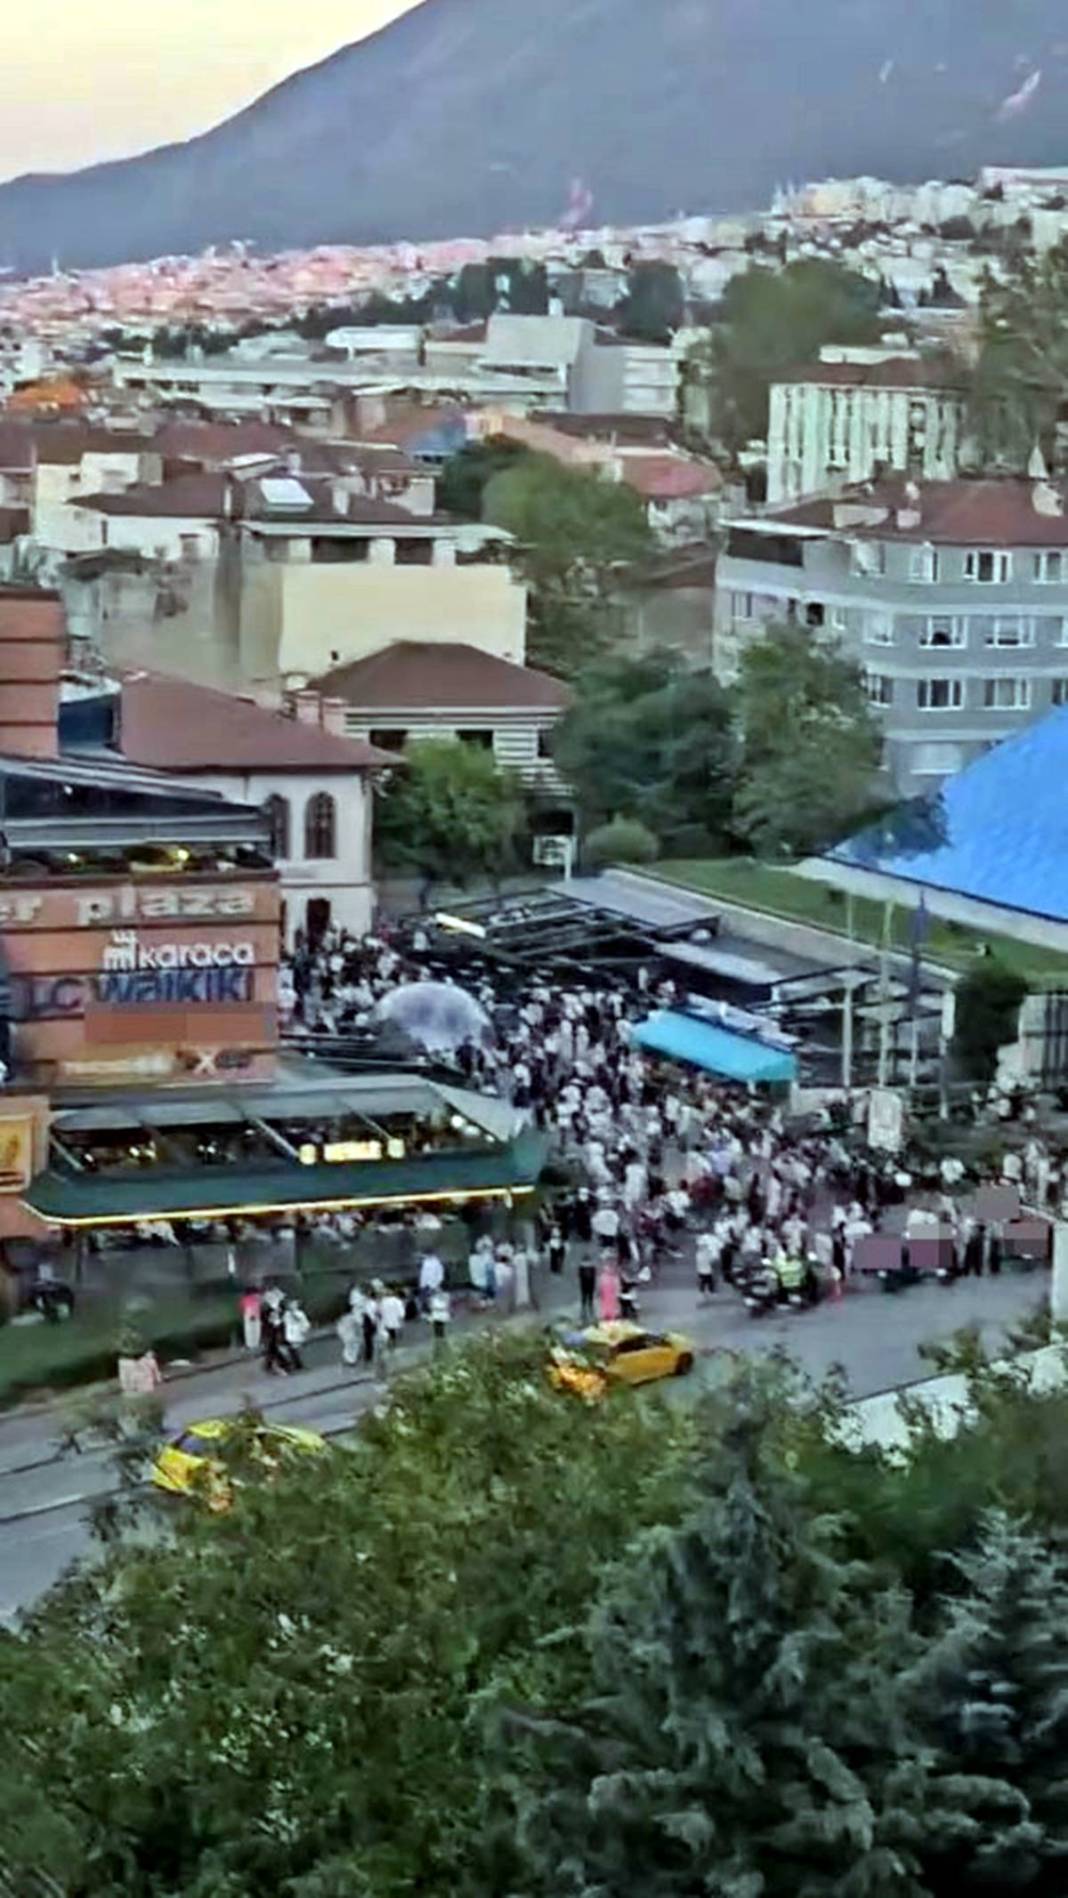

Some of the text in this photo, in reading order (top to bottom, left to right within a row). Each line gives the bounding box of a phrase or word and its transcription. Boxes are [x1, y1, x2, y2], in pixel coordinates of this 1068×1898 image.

[77, 885, 255, 927] plaza
[139, 942, 255, 968] karaca
[29, 976, 82, 1012] LC
